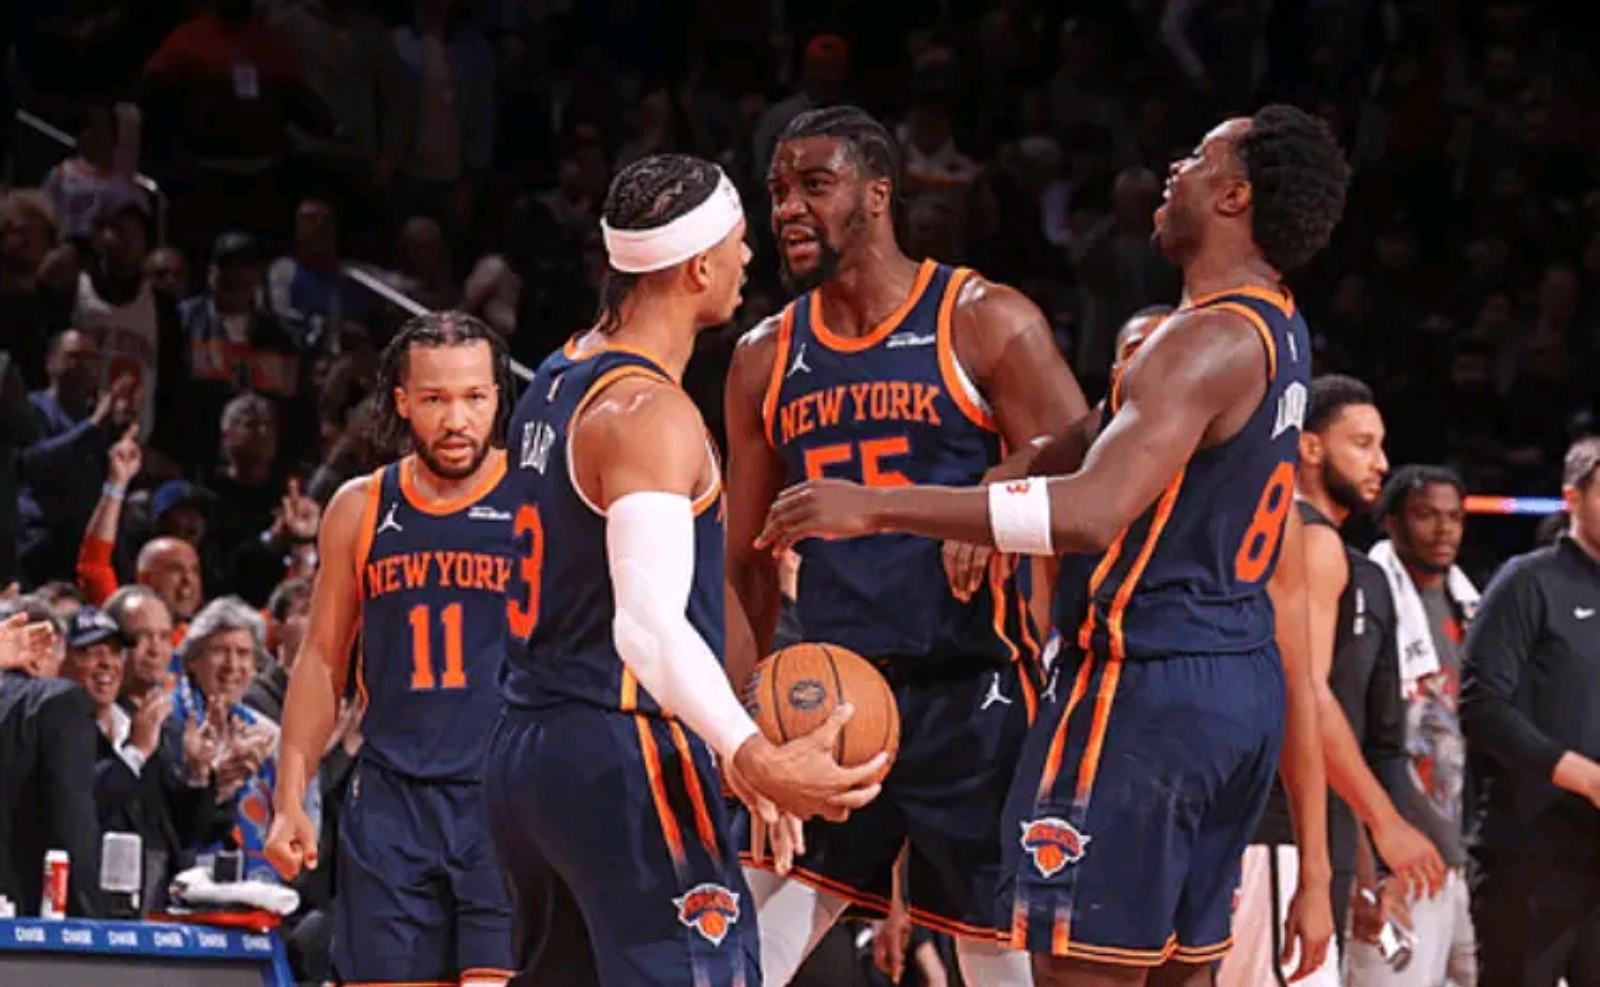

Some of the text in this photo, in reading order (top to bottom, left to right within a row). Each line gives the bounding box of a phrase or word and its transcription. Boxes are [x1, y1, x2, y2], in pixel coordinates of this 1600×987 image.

[780, 381, 942, 444] NEW YORK
[1234, 460, 1295, 582] 8
[368, 552, 432, 598] NEW
[506, 504, 544, 640] 3
[408, 603, 467, 689] 11
